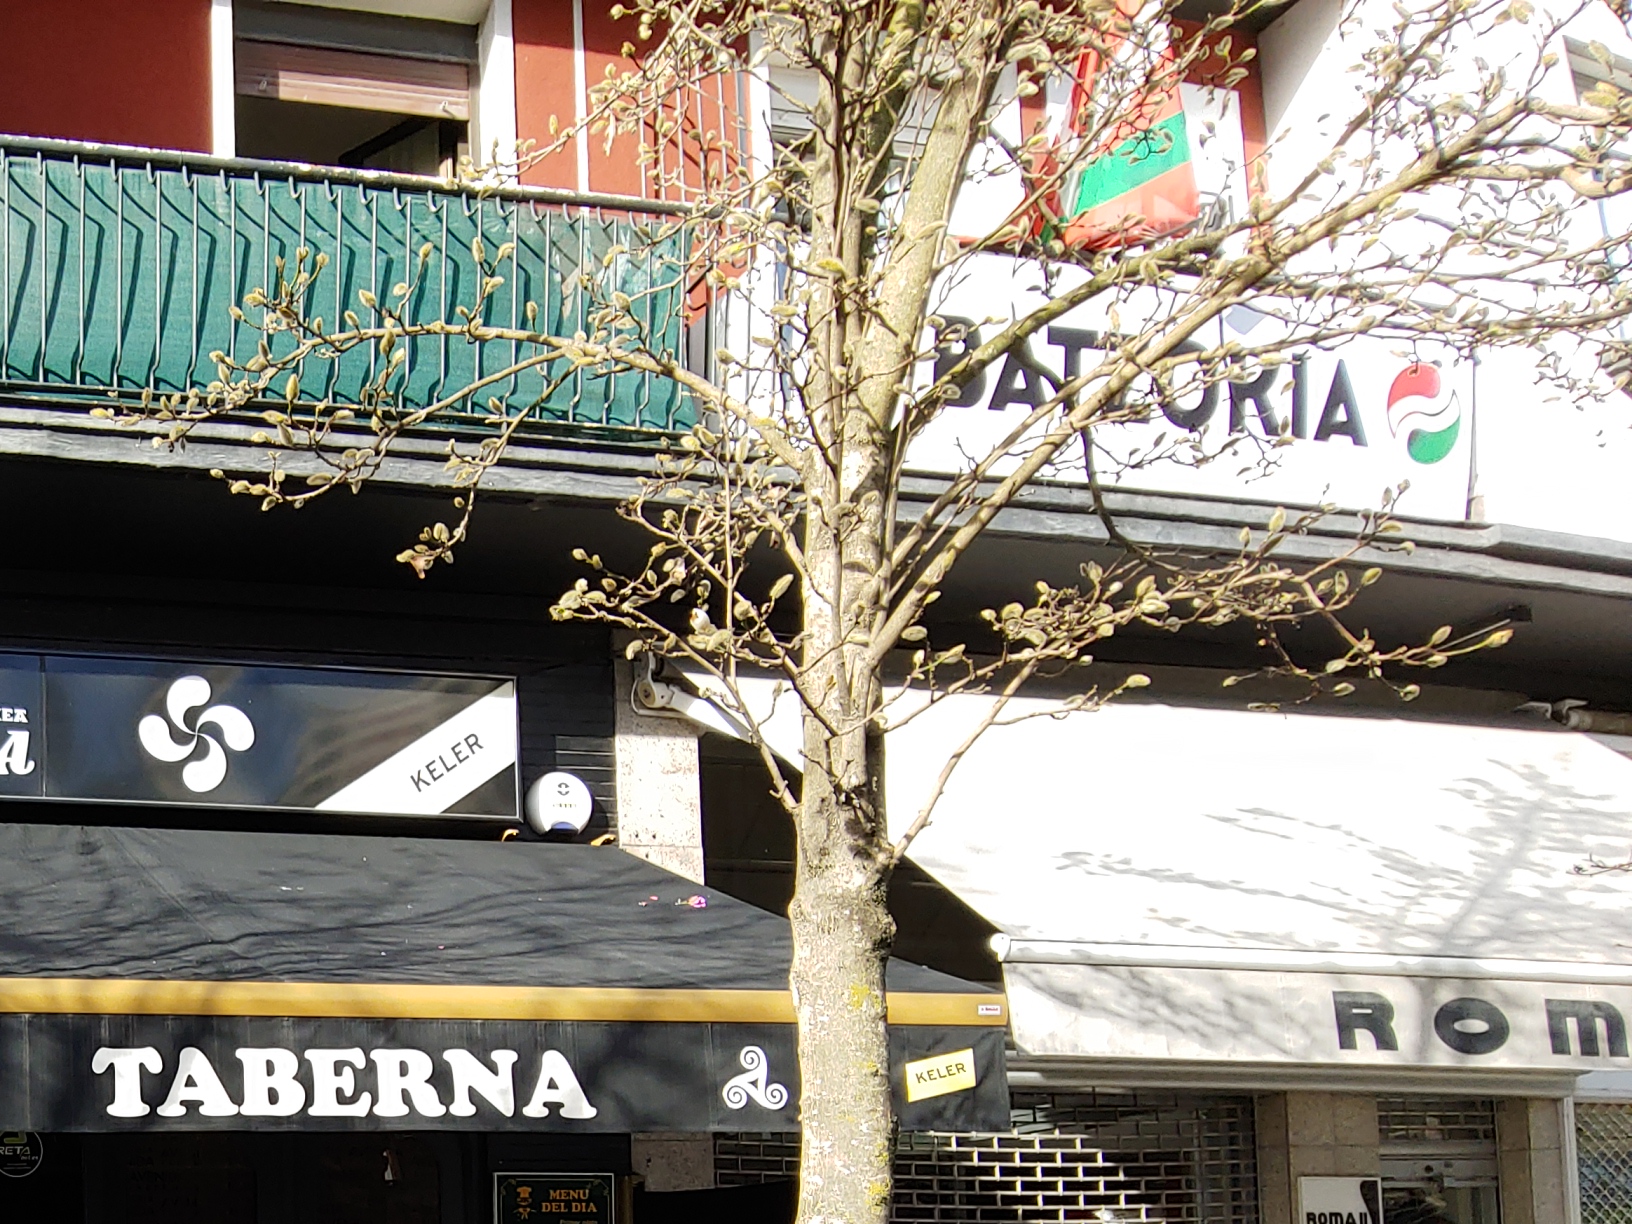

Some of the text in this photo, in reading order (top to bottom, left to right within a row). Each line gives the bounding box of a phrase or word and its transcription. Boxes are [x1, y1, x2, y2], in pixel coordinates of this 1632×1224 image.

[409, 733, 484, 793] KELER
[91, 1046, 598, 1120] TABERNA
[915, 1063, 967, 1084] KELER
[542, 1202, 598, 1213] DEL DIA
